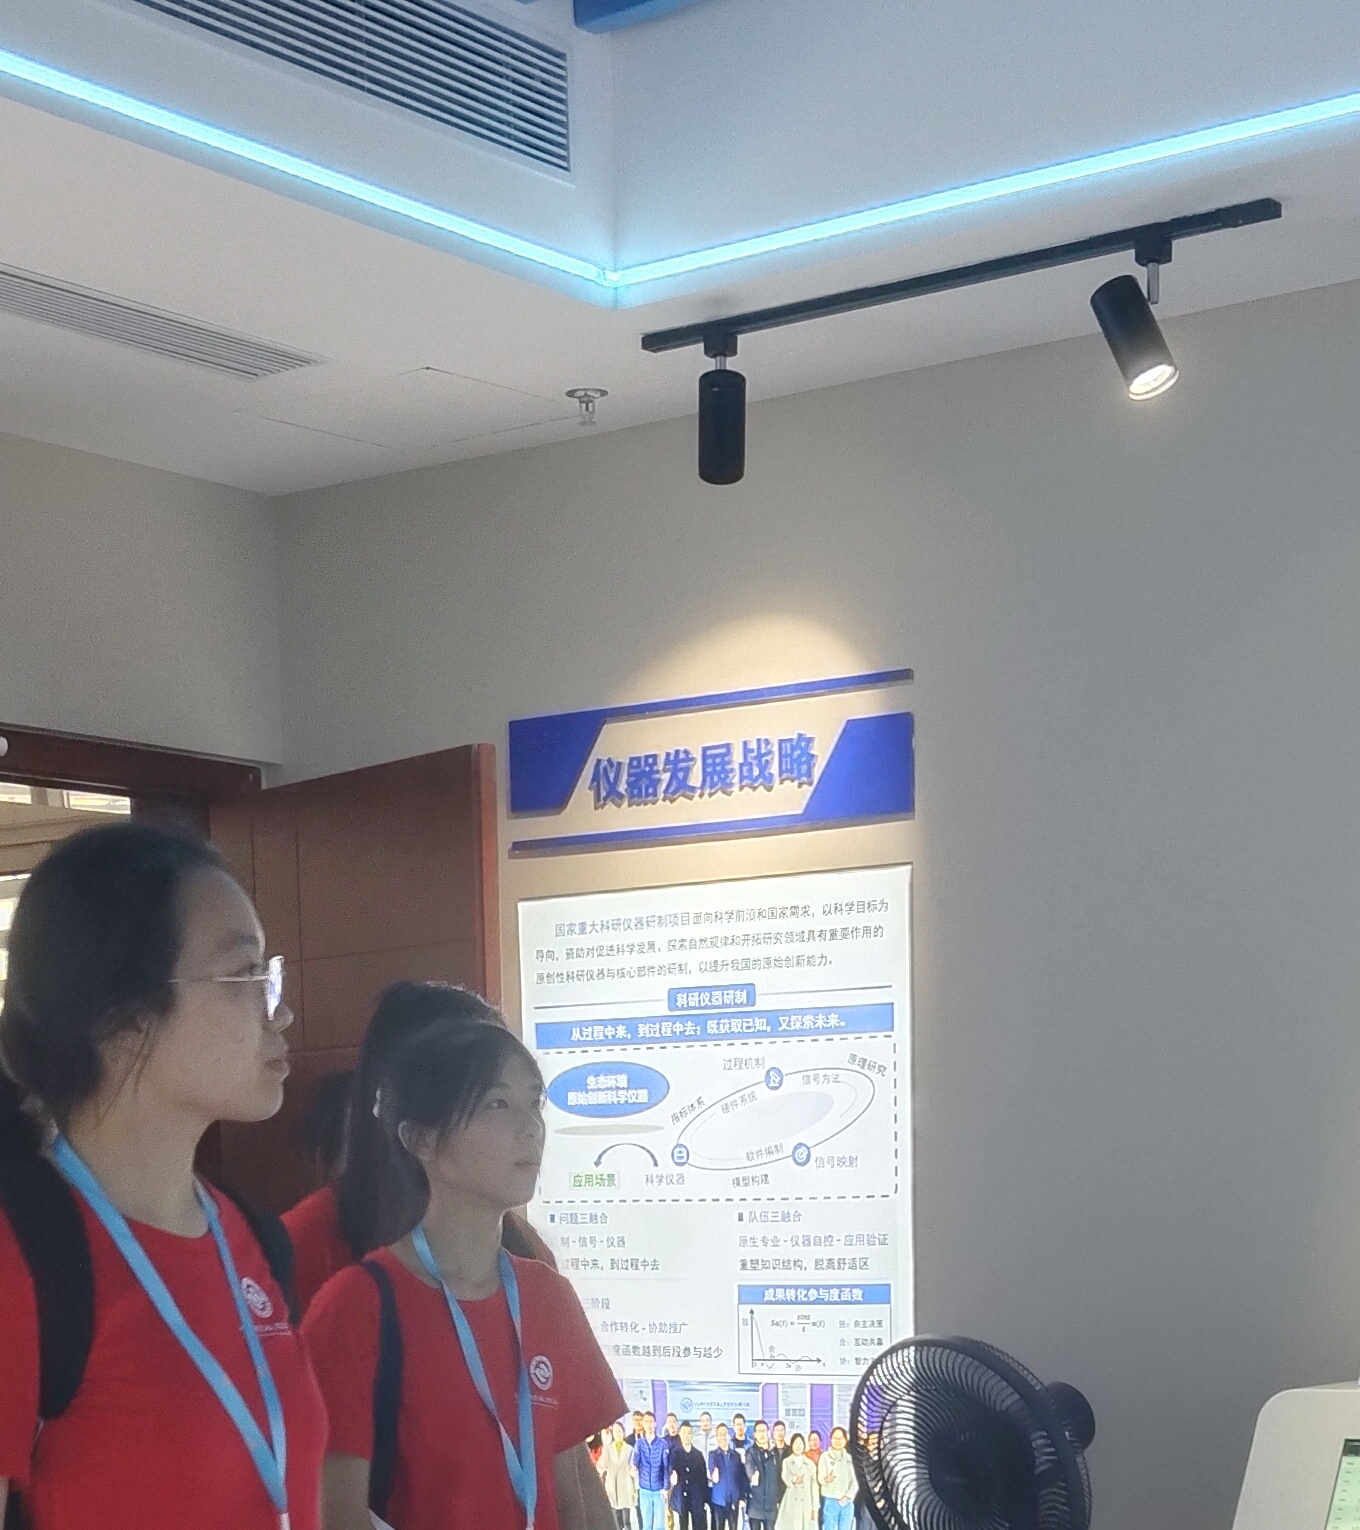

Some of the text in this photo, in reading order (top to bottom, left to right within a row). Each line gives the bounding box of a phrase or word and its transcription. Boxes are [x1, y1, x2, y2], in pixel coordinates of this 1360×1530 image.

[589, 733, 817, 809] 仪器发展战略
[554, 898, 889, 938] 国家重大科研仪器研制项目面向科学前沿和国家需求，以科学目标为
[536, 953, 833, 985] 原创性科研仪器与核心部件的研制，以提升我国的原始创新能力。
[675, 990, 747, 1009] 科研仪器研制
[571, 1012, 846, 1042] 从过程中来，到过程中去；既获取已知，又探索未来。
[722, 1056, 766, 1072] 过程机制
[847, 1052, 887, 1078] 原理研究
[802, 1073, 841, 1086] 信号方法
[720, 1091, 758, 1114] 硬件系统
[814, 1156, 859, 1169] 信号映射
[572, 1173, 617, 1188] 应用场景
[644, 1172, 686, 1187] 科学仪器
[731, 1173, 770, 1188] 模型构建
[559, 1212, 609, 1225] 问题三融合
[748, 1210, 803, 1223] 队伍三融合
[556, 1235, 626, 1249] 制-信号-仪器
[763, 1287, 864, 1302] 成果转化参与度函数
[608, 1344, 724, 1359] 度函数越到后段参与越少
